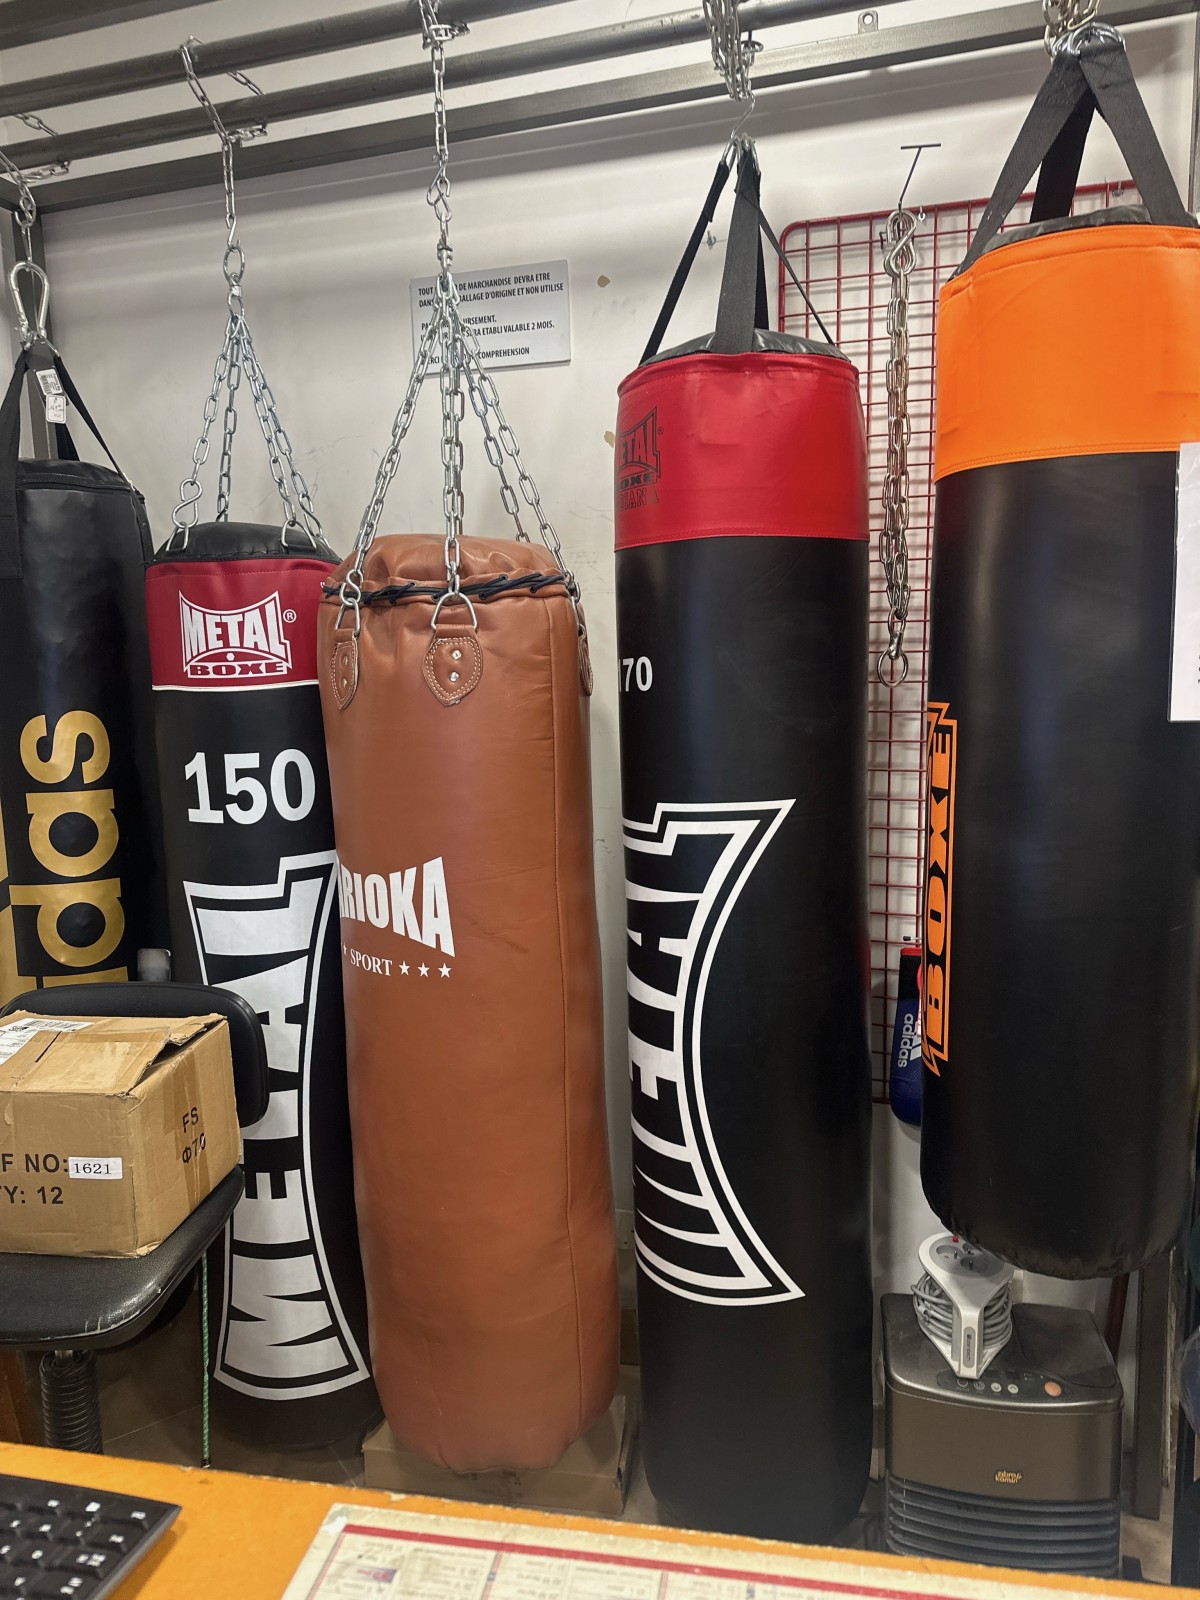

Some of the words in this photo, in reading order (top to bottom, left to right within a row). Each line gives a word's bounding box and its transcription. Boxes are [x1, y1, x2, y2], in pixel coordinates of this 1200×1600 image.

[418, 287, 433, 296] TOUT
[458, 283, 467, 291] DE
[468, 277, 512, 290] MARCHANDISE
[513, 274, 535, 285] DEVRA
[536, 272, 551, 282] ETRE
[485, 289, 516, 299] D'ORIGINE
[517, 288, 525, 296] ET
[525, 286, 540, 295] NON
[541, 283, 564, 293] UTILISE
[482, 325, 503, 336] ETABLI
[503, 322, 530, 333] VALABLE
[531, 322, 536, 330] 2
[537, 320, 555, 330] MOIS.
[478, 347, 530, 360] COMPREHENSION
[180, 593, 290, 666] METAL
[189, 661, 286, 677] BOXE
[619, 656, 653, 692] 70
[184, 748, 316, 825] 150
[926, 729, 952, 1050] BOXE
[350, 948, 393, 977] SPORT
[897, 1012, 914, 1069] adidas
[182, 1106, 199, 1134] FS
[24, 1153, 69, 1174] NO:
[73, 1162, 112, 1176] 1621
[0, 1185, 26, 1204] Y:
[36, 1185, 64, 1205] 12
